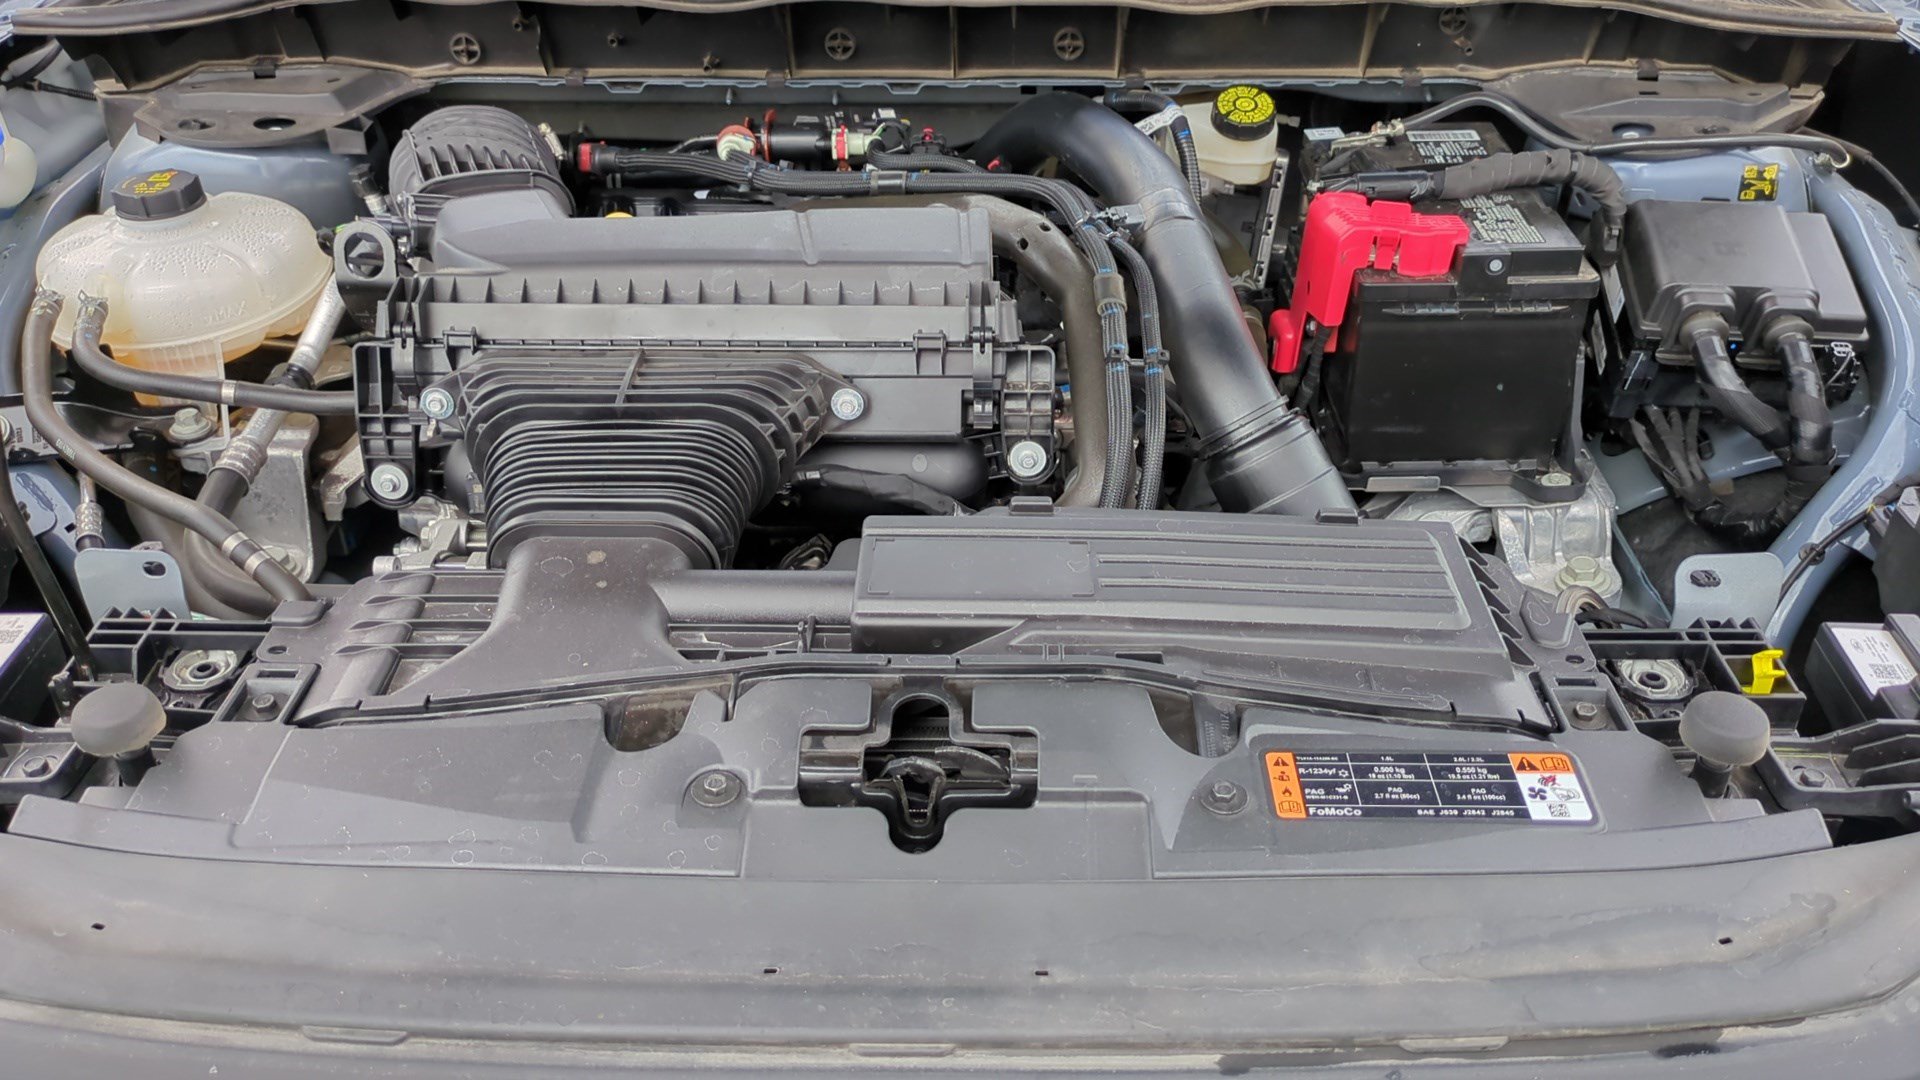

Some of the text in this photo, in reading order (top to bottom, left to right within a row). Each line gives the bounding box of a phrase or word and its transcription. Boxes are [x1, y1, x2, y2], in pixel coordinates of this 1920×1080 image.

[1298, 767, 1336, 775] R-1234yf
[1394, 766, 1405, 775] kg
[1476, 766, 1488, 775] kg
[1308, 806, 1362, 816] FoMoCo
[1417, 808, 1436, 816] SAE
